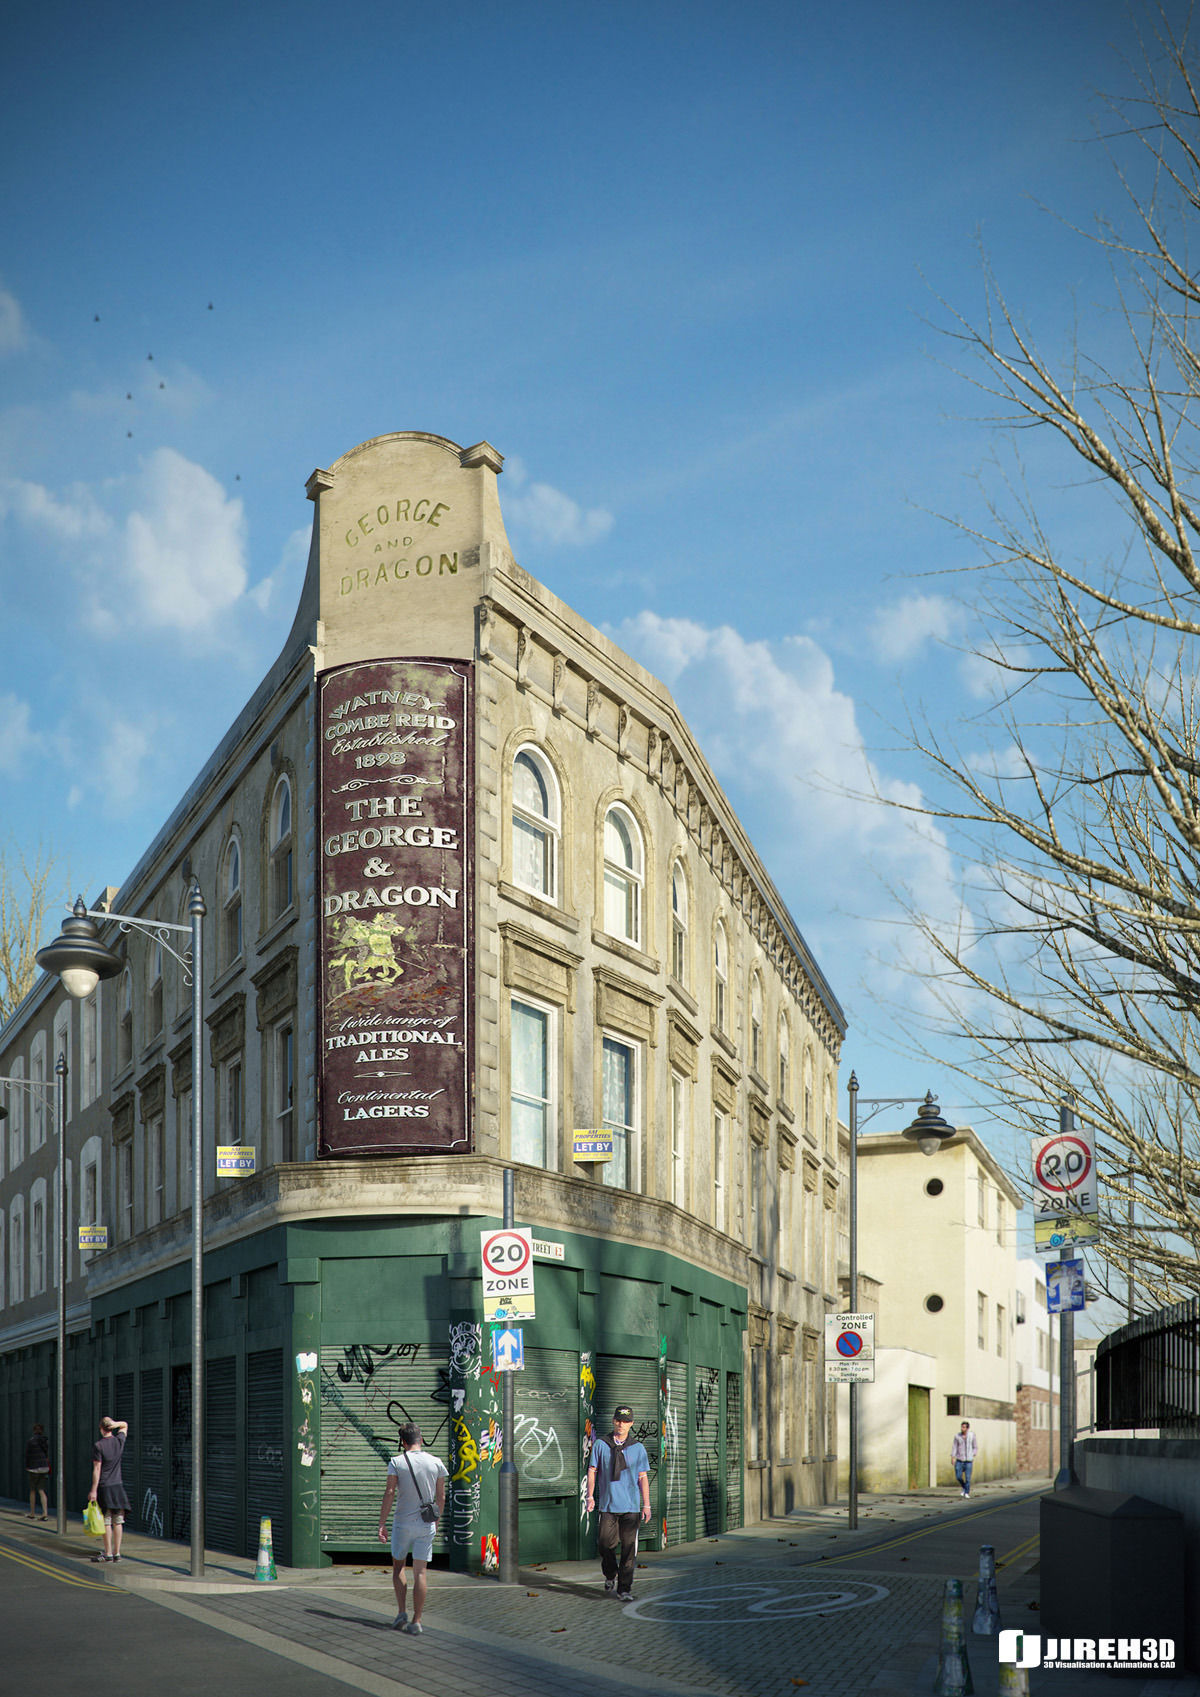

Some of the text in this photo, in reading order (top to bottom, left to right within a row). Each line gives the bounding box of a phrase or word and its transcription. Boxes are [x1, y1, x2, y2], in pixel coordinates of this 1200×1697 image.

[345, 498, 450, 548] GEORGE
[374, 536, 413, 554] AND
[340, 552, 458, 596] DRAGON
[328, 690, 445, 720] WATNEY
[325, 714, 456, 740] COMBE REID
[331, 730, 450, 756] Established
[354, 752, 406, 770] 1898
[344, 796, 424, 822] THE
[324, 825, 458, 857] GEORGE
[362, 857, 394, 878] &
[324, 885, 459, 918] DRAGON
[348, 1013, 382, 1028] wide
[382, 1016, 433, 1028] range
[433, 1016, 458, 1028] of
[326, 1030, 462, 1050] TRADITIONAL
[355, 1048, 410, 1064] ALES
[337, 1088, 445, 1104] Continental
[343, 1105, 430, 1121] LAGERS
[576, 1143, 610, 1151] LET BY
[1044, 1150, 1083, 1178] 20
[1040, 1192, 1090, 1212] ZONE
[490, 1244, 524, 1263] 20
[532, 1243, 550, 1254] TREET
[486, 1277, 529, 1292] ZONE
